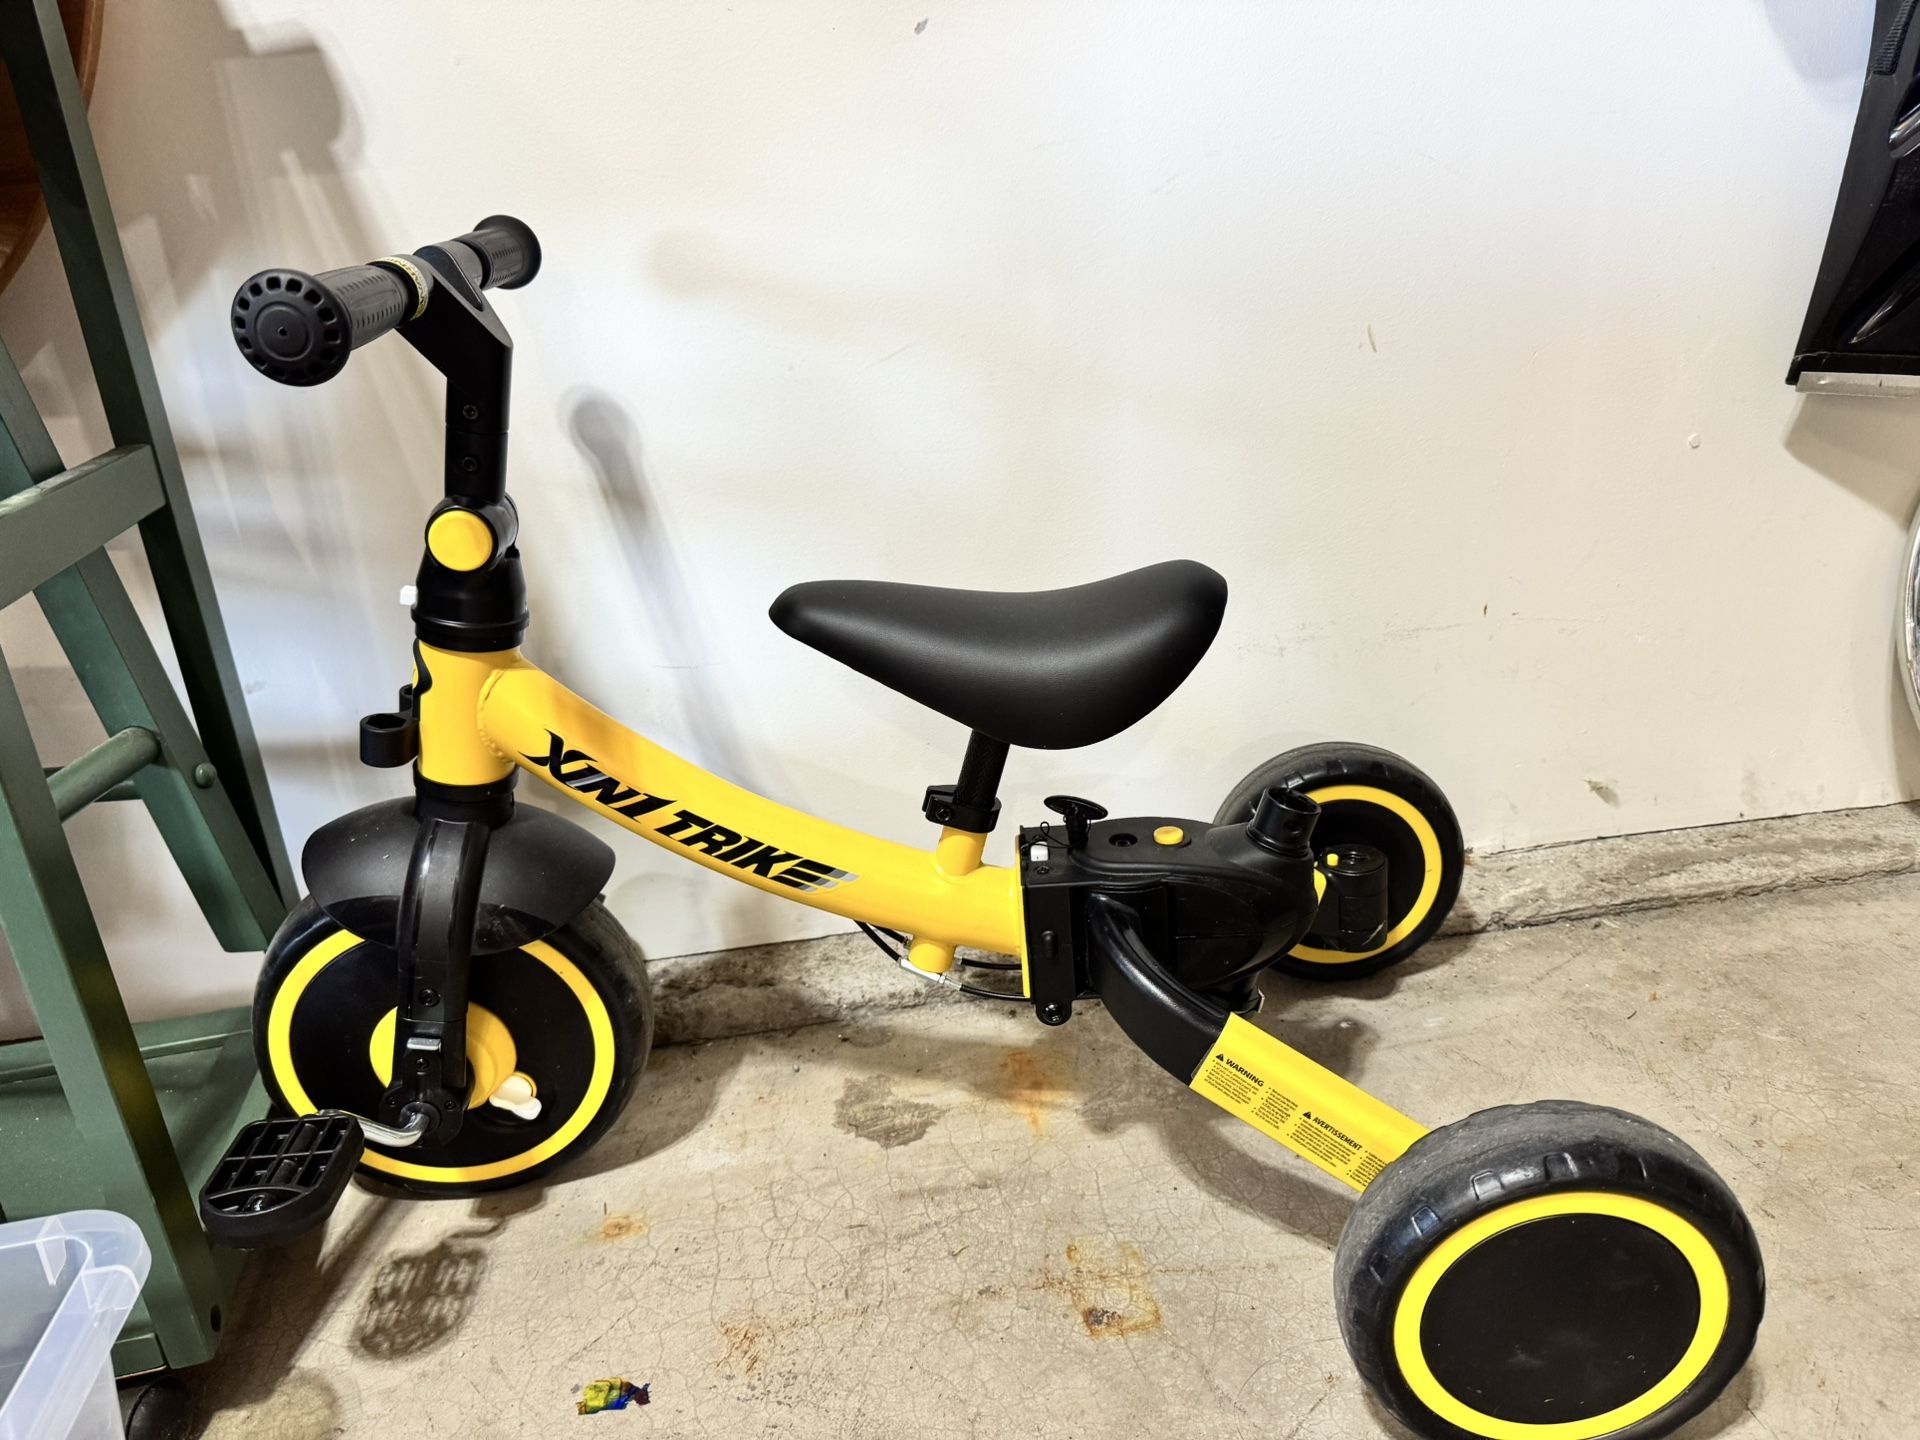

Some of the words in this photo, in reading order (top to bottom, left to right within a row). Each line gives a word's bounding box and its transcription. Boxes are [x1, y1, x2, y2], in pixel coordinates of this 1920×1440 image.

[653, 809, 858, 892] TRIKE
[1226, 1058, 1264, 1087] WARNING
[1312, 1117, 1363, 1151] AVERTISSEMENT
